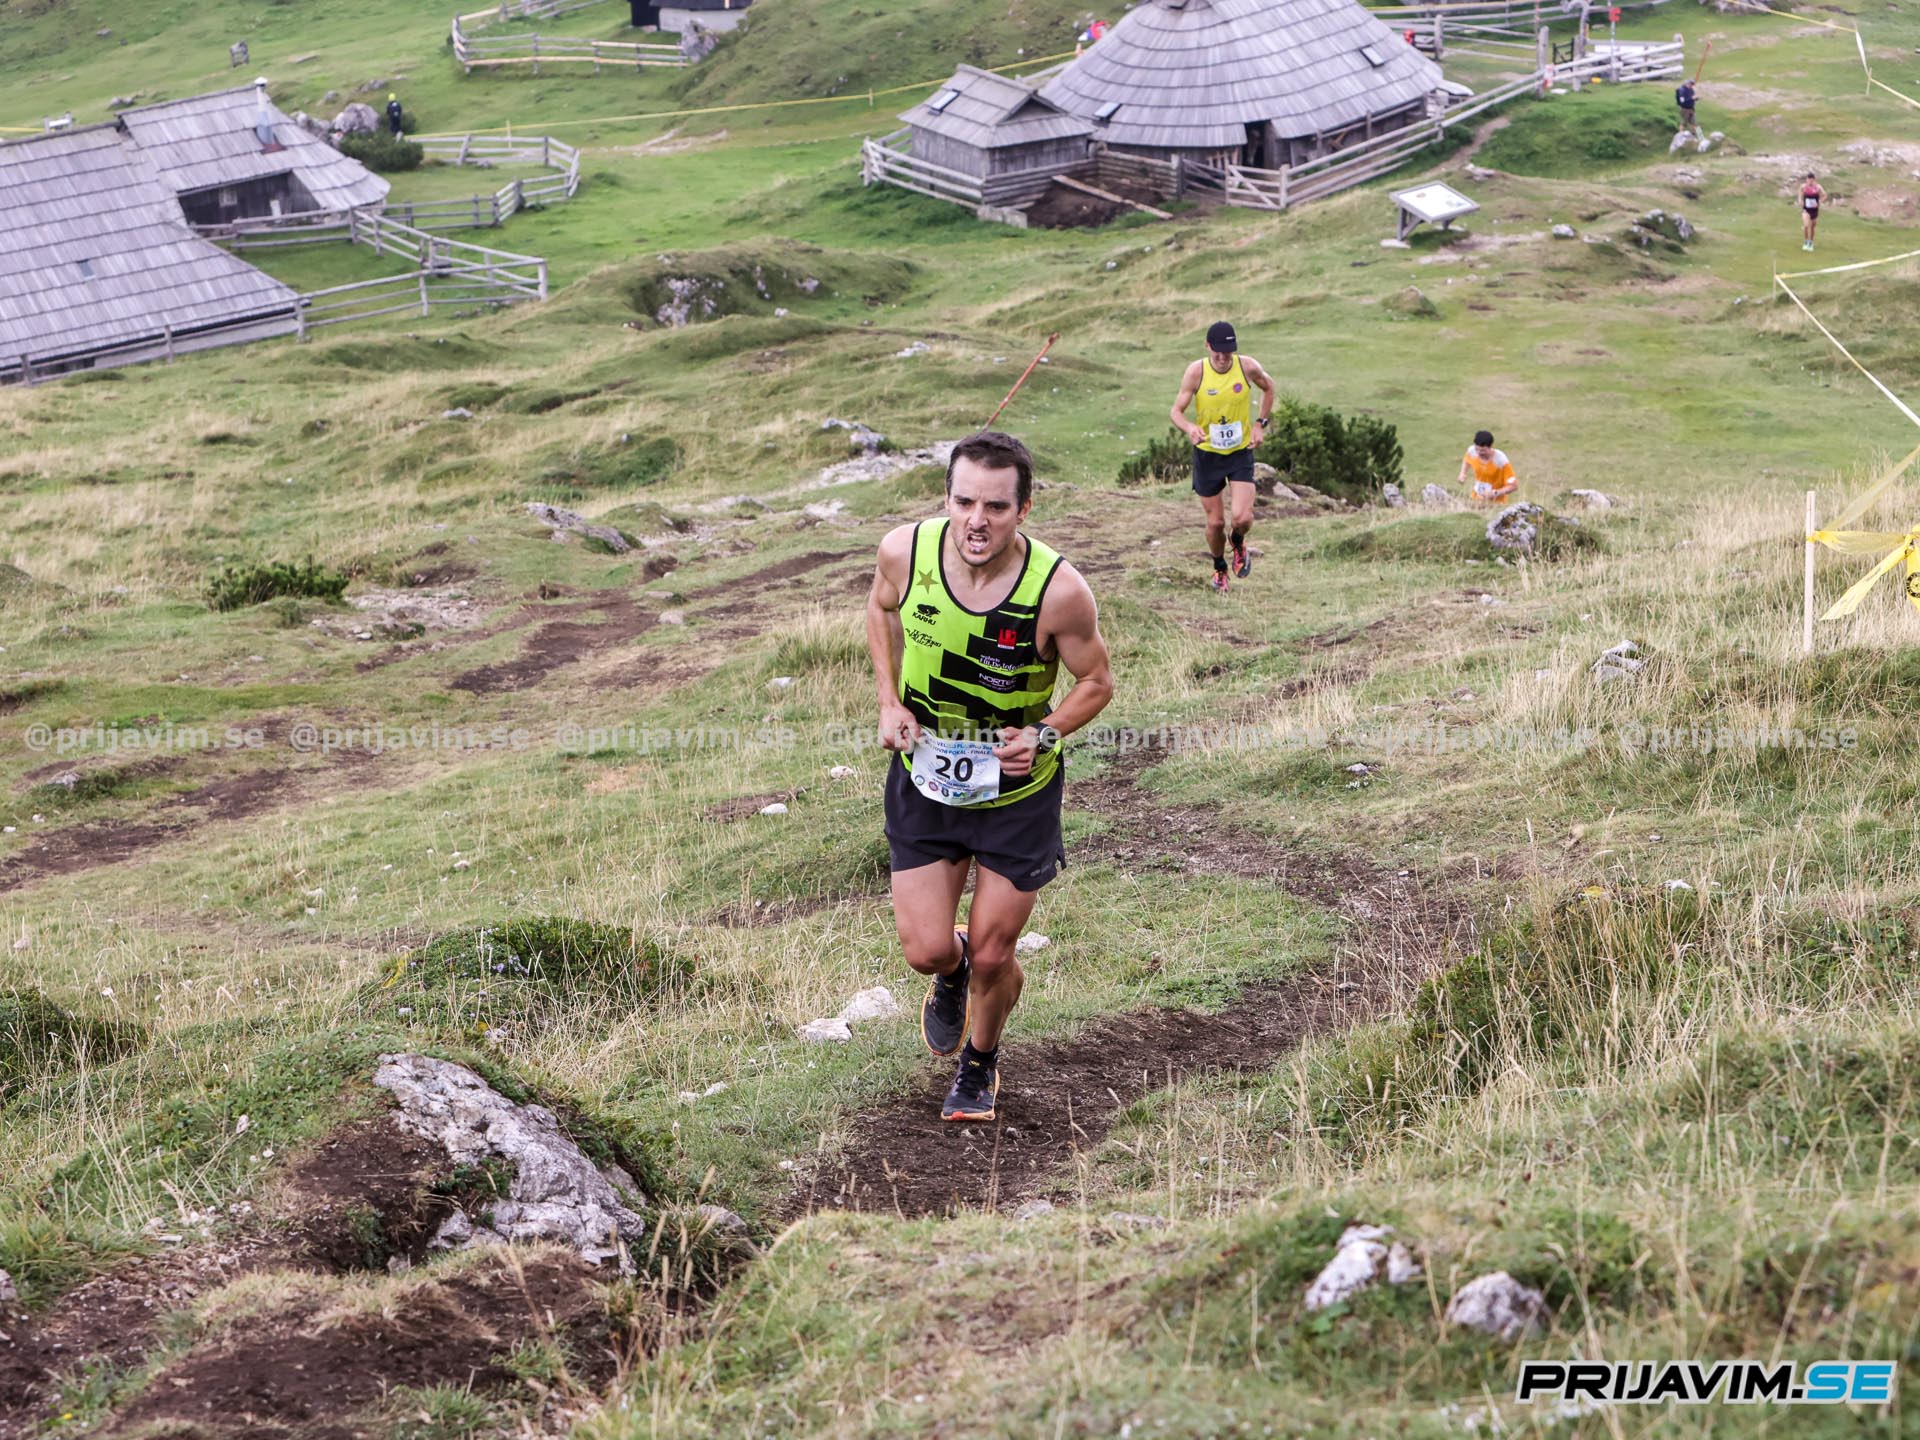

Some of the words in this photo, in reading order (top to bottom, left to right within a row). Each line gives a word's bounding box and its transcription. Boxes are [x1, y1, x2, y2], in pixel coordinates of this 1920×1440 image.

[1220, 430, 1233, 439] 10
[912, 611, 936, 625] KARHU
[935, 755, 973, 782] 20
